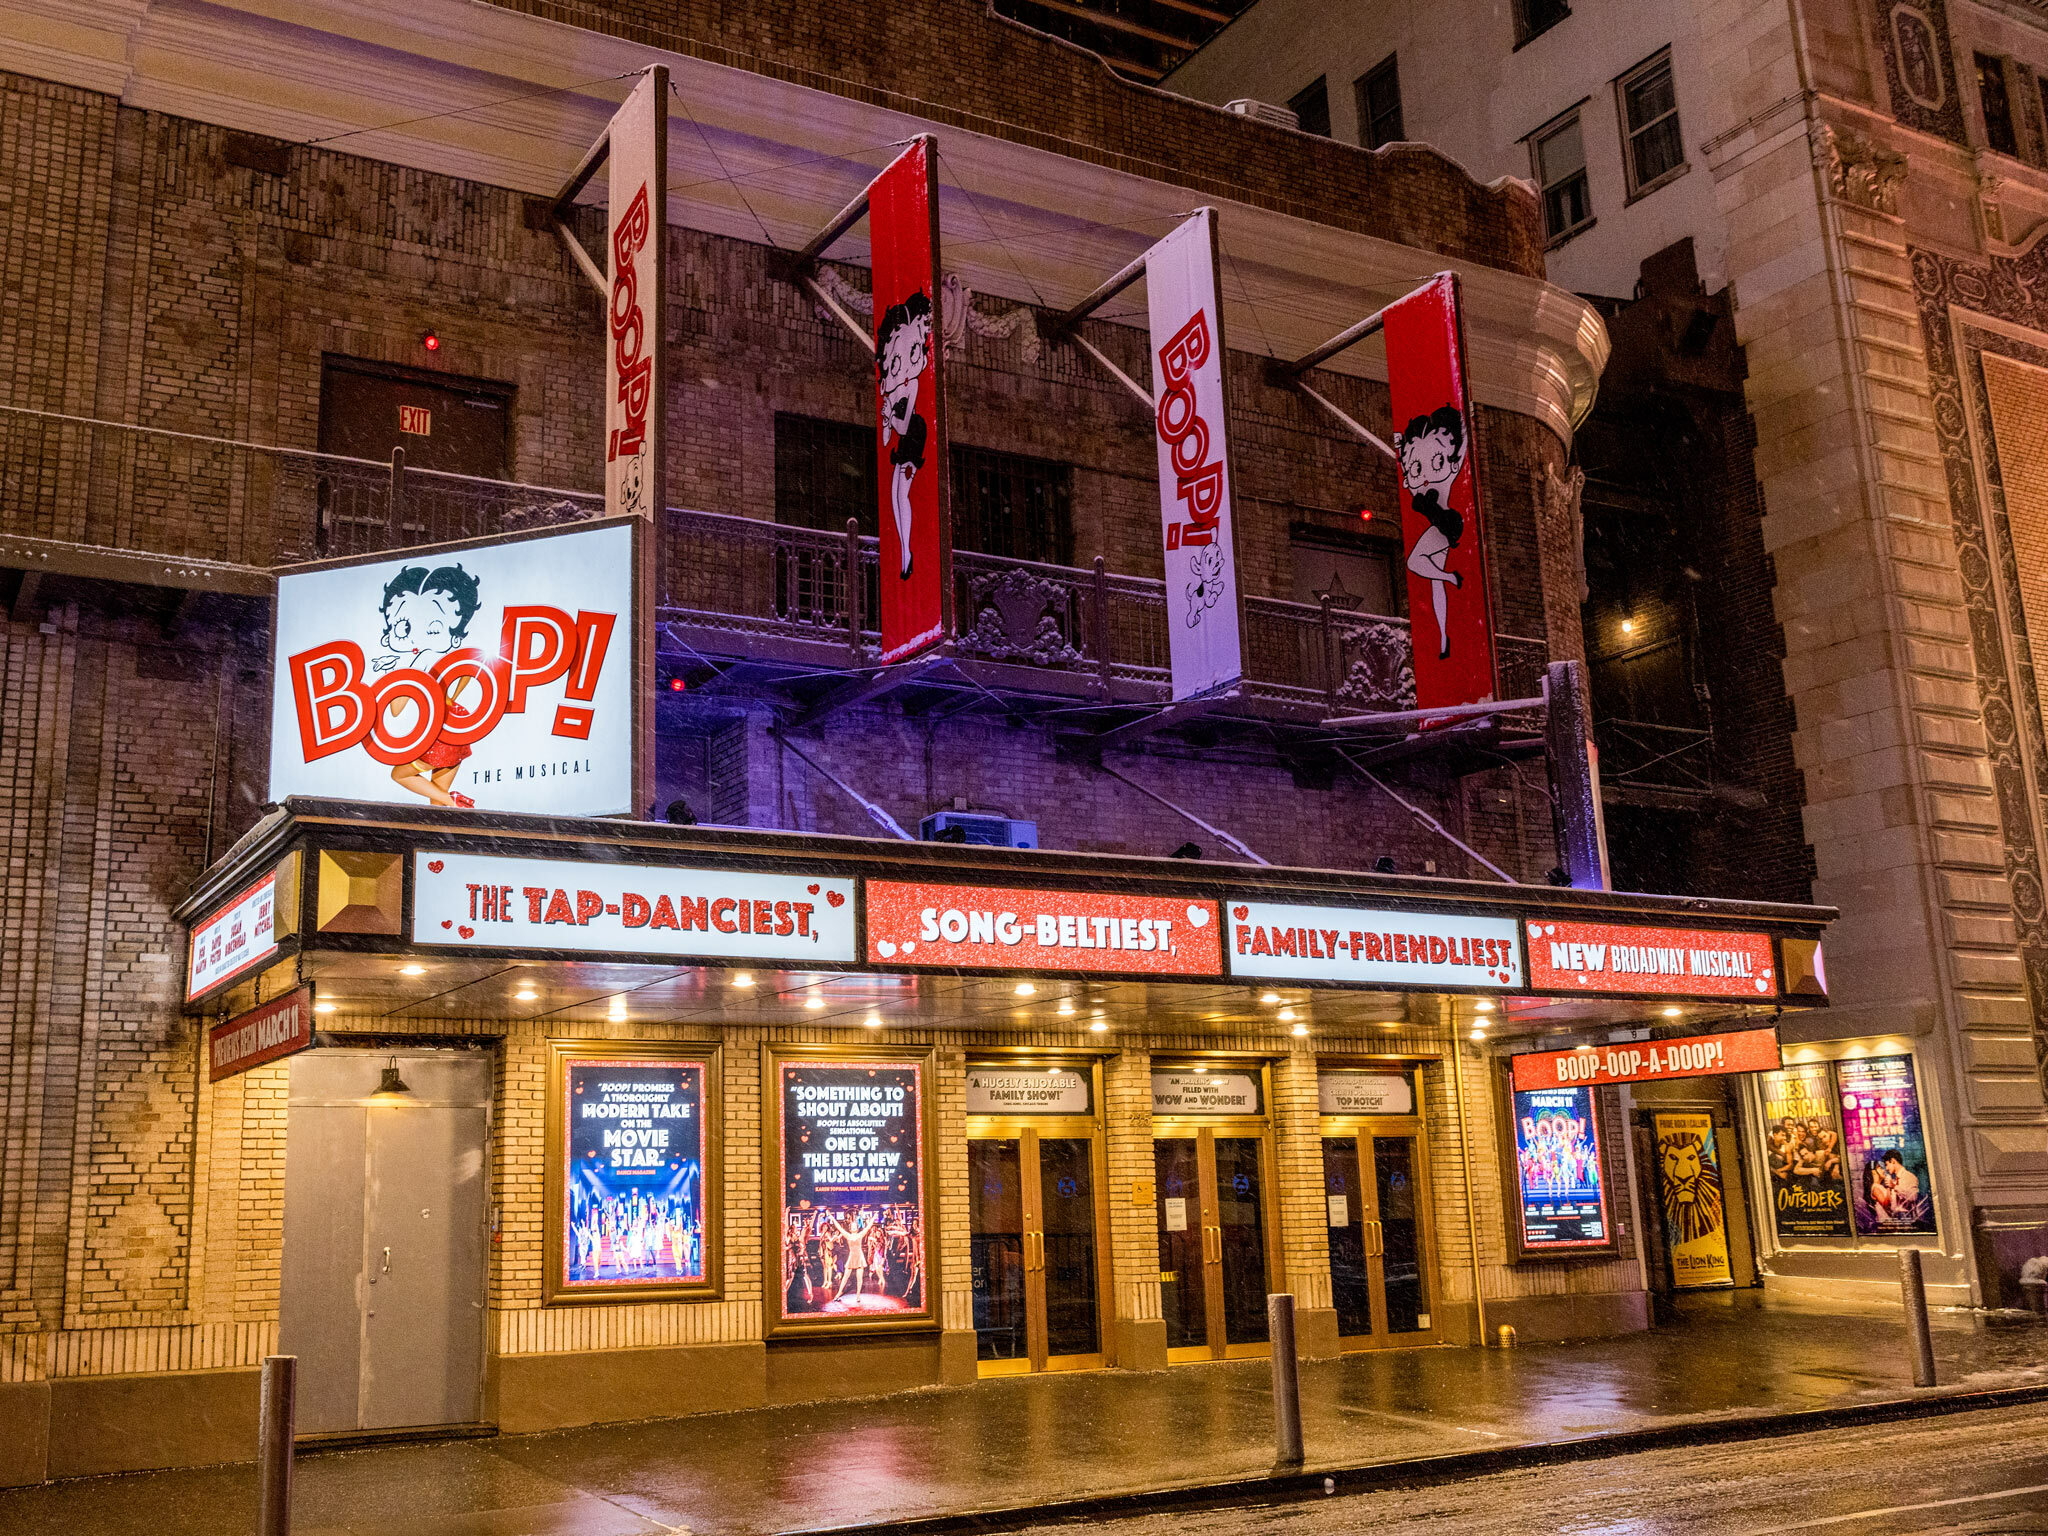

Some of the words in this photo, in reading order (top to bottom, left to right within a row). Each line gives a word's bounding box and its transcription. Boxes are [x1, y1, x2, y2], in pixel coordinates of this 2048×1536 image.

[608, 180, 652, 463] BOOP!
[400, 406, 430, 434] EXIT
[1158, 307, 1223, 550] BOOP!
[288, 604, 617, 766] BOOP!
[473, 769, 503, 785] THE
[516, 759, 592, 780] MUSICAL
[466, 883, 514, 923] THE
[523, 886, 819, 943] TAP-DANCIEST,
[920, 907, 1178, 956] SONG-BELTIEST,
[1235, 924, 1517, 972] FAMILY-FRIENDLIEST,
[1550, 942, 1608, 972] NEW
[1611, 945, 1686, 975] BROADWAY
[1690, 949, 1754, 978] MUSICAL!
[258, 1008, 290, 1051] MARCH
[291, 1003, 299, 1038] 11
[1556, 1041, 1724, 1082] BOOP-OOP-A-DOOP!
[1841, 1064, 1858, 1073] BEST
[1859, 1064, 1870, 1072] OF
[1871, 1062, 1884, 1070] THE
[1885, 1061, 1905, 1069] YEAR
[633, 1083, 675, 1092] PROMISES
[982, 1078, 1020, 1088] HUGELY
[1023, 1078, 1076, 1088] ENJOYABLE
[1776, 1079, 1812, 1099] BEST
[603, 1094, 610, 1102] A
[611, 1094, 670, 1102] THOROUGHLY
[884, 1086, 905, 1101] TO
[989, 1090, 1025, 1101] FAMILY
[1155, 1095, 1182, 1105] WOW
[1336, 1097, 1352, 1105] TOP
[1531, 1096, 1562, 1107] MARCH
[1564, 1096, 1573, 1107] 11
[1766, 1098, 1831, 1119] MUSICAL
[582, 1104, 649, 1118] MODERN
[651, 1104, 690, 1118] TAKE
[797, 1102, 847, 1117] SHOUT
[849, 1102, 903, 1116] ABOUT!
[1858, 1107, 1902, 1118] MAYBE
[620, 1120, 635, 1128] ON
[636, 1120, 652, 1128] THE
[847, 1119, 886, 1127] ABSOLUTELY
[1521, 1115, 1586, 1140] BOOP!
[1860, 1116, 1903, 1127] HAPPY
[1862, 1125, 1904, 1136] ENDING
[603, 1129, 669, 1148] MOVIE
[825, 1136, 857, 1151] ONE
[859, 1136, 879, 1151] OF
[803, 1152, 830, 1167] THE
[832, 1152, 865, 1167] BEST
[867, 1152, 901, 1167] NEW
[1778, 1188, 1843, 1211] OUTSIDERS
[1677, 1257, 1689, 1266] THE
[1689, 1254, 1706, 1269] LION
[1706, 1254, 1724, 1268] KING
